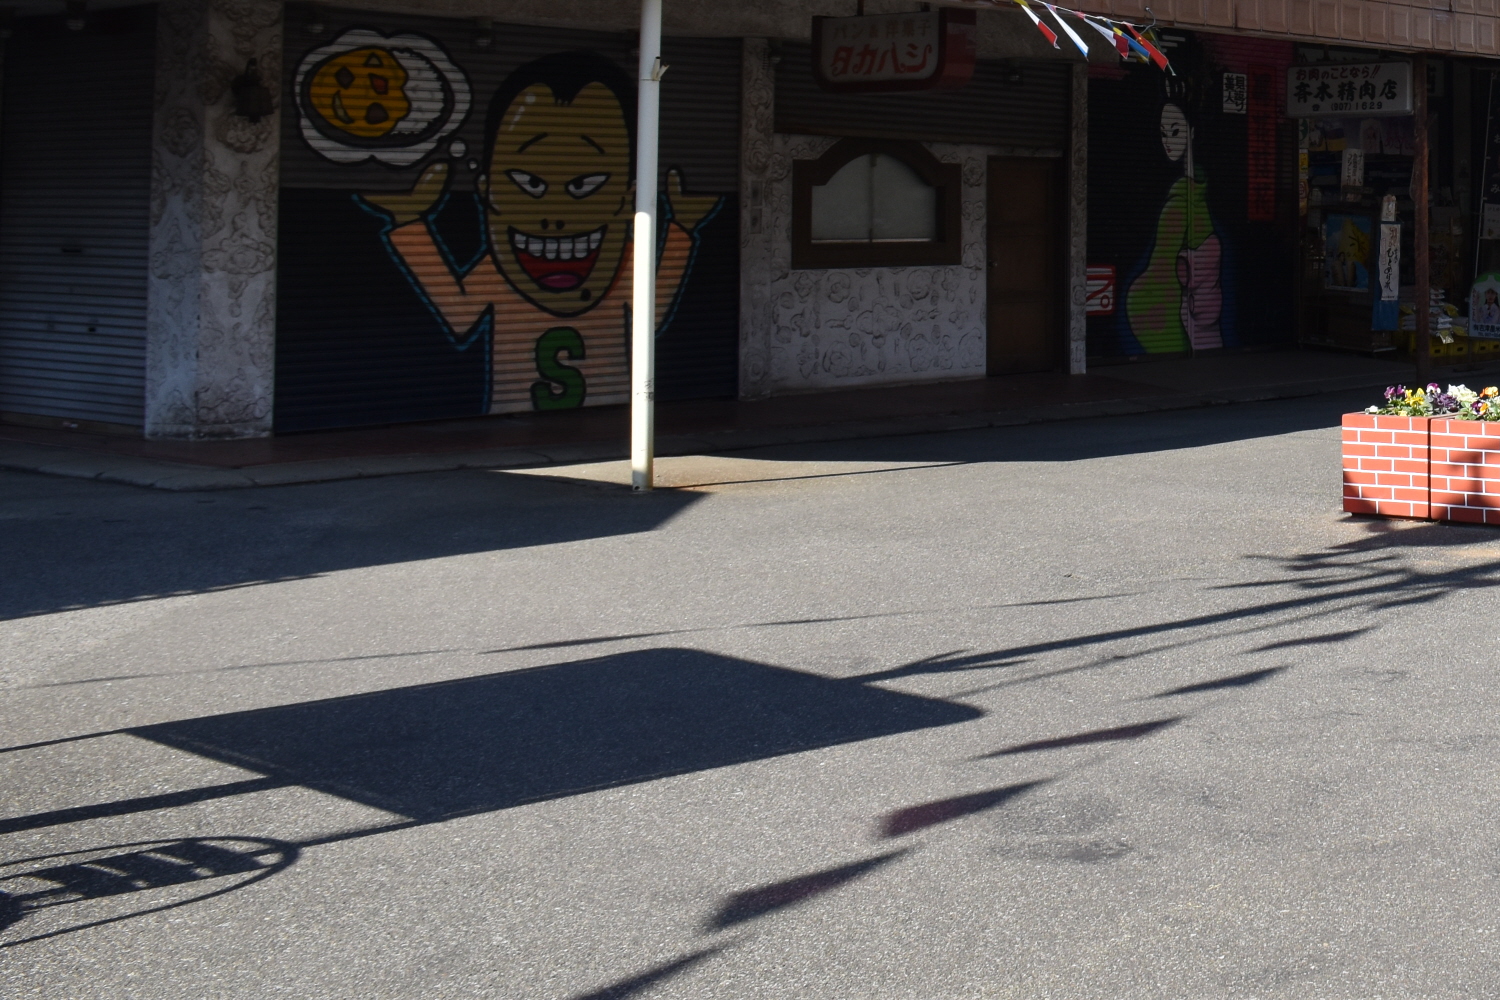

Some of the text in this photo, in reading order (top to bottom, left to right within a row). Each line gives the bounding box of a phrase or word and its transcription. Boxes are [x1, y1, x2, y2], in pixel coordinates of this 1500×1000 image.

[830, 42, 932, 76] タカハシ
[1224, 74, 1235, 103] 美人
[1234, 75, 1246, 112] 見返り
[1331, 101, 1383, 111] (907)1629
[531, 326, 586, 411] S
